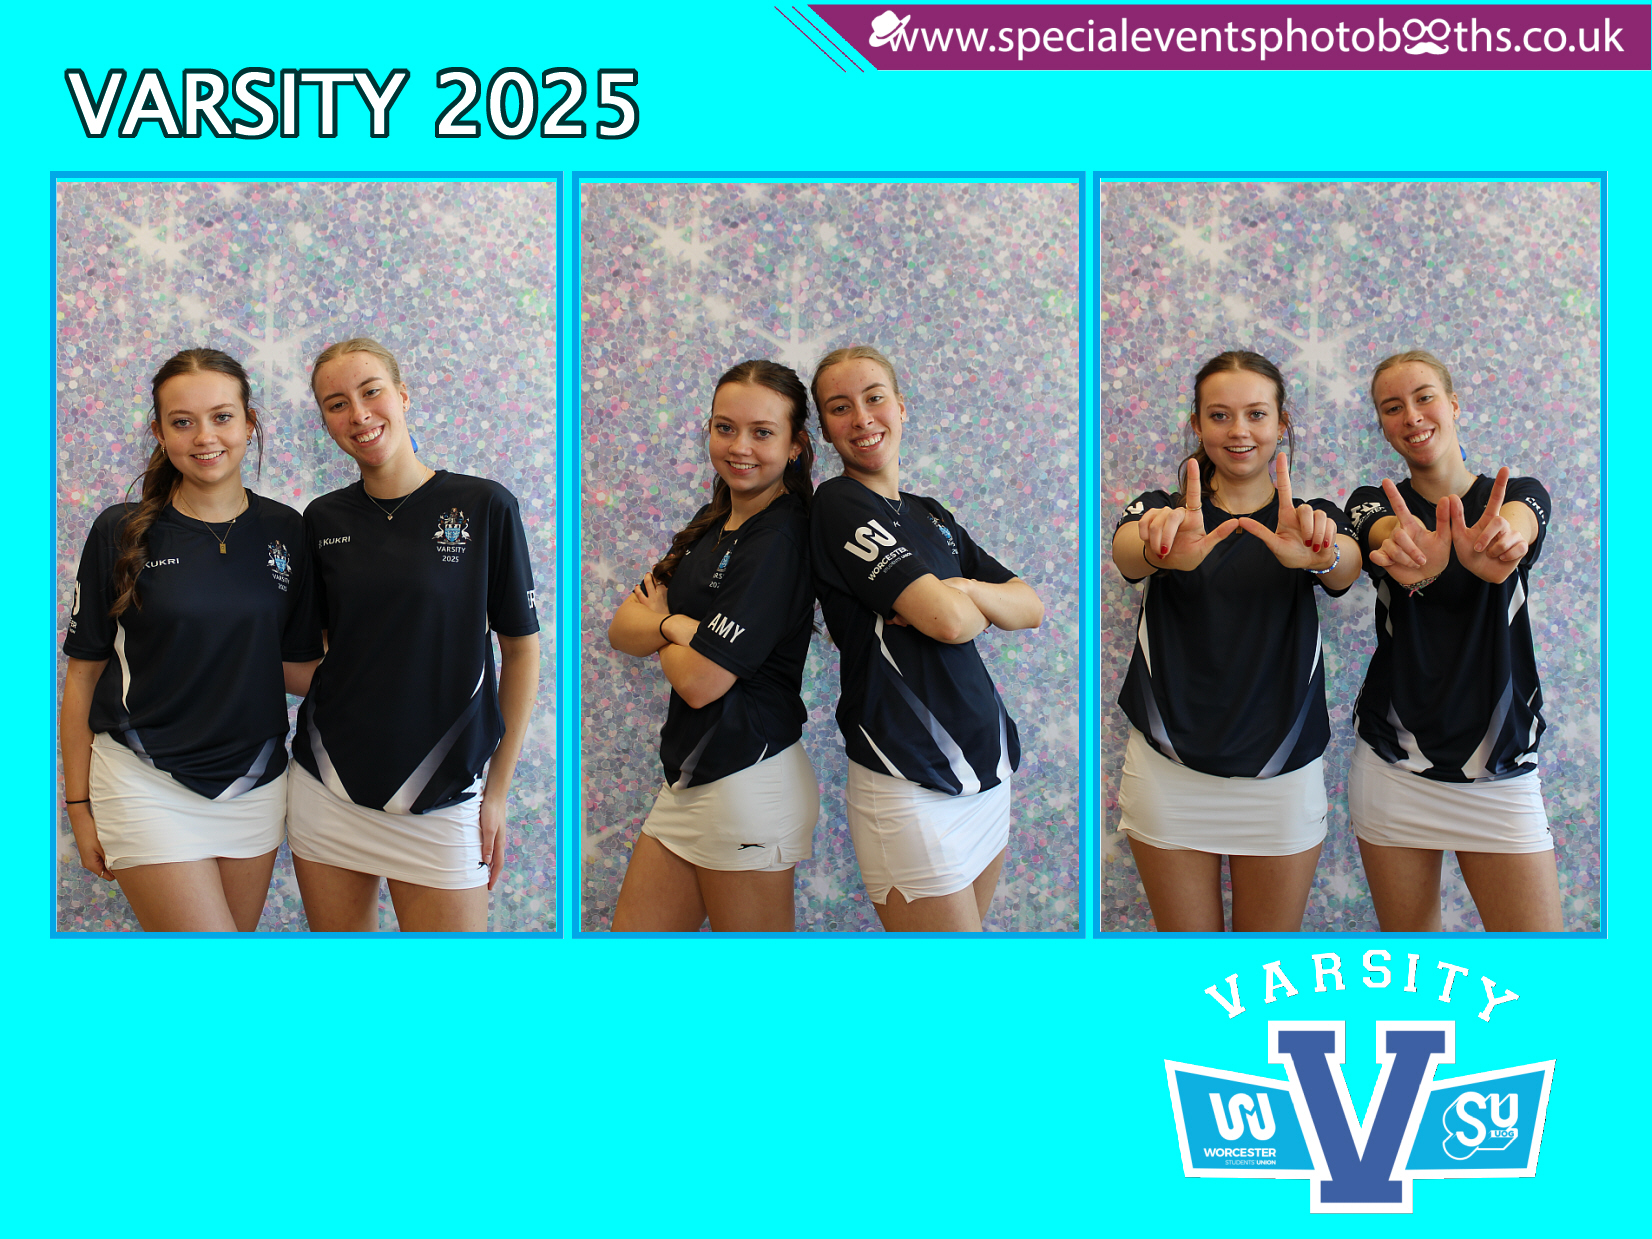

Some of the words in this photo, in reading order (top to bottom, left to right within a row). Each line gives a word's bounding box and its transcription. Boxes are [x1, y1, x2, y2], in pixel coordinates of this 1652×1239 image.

[323, 535, 351, 547] KUKRI
[436, 546, 466, 554] VARSITY
[442, 555, 460, 563] 2025
[707, 612, 746, 644] AMY
